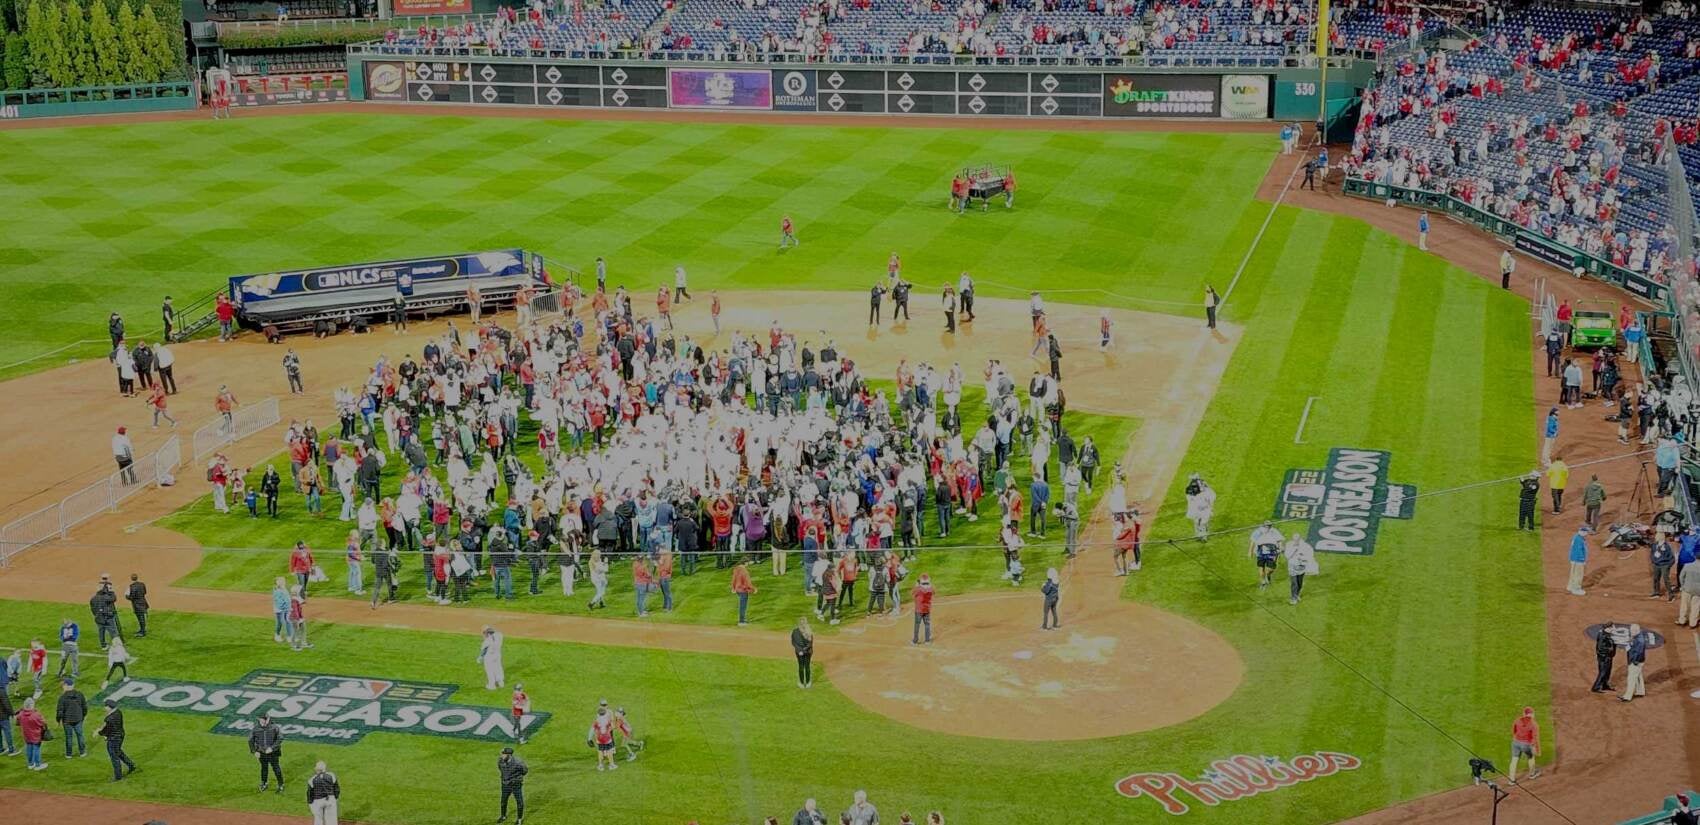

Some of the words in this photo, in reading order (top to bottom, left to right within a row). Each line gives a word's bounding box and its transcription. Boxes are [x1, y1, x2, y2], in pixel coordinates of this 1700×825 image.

[791, 79, 800, 88] R
[1295, 82, 1315, 95] 330
[1113, 90, 1214, 104] DRAFTKINGS
[0, 105, 19, 118] 401
[1136, 103, 1213, 112] SPORTSBOOK
[338, 267, 381, 288] NLCS
[1314, 449, 1382, 553] POSTSEASON
[247, 675, 304, 689] 20
[386, 686, 443, 698] 22
[107, 680, 538, 739] POSTSEASON
[1114, 751, 1362, 816] Phillies
